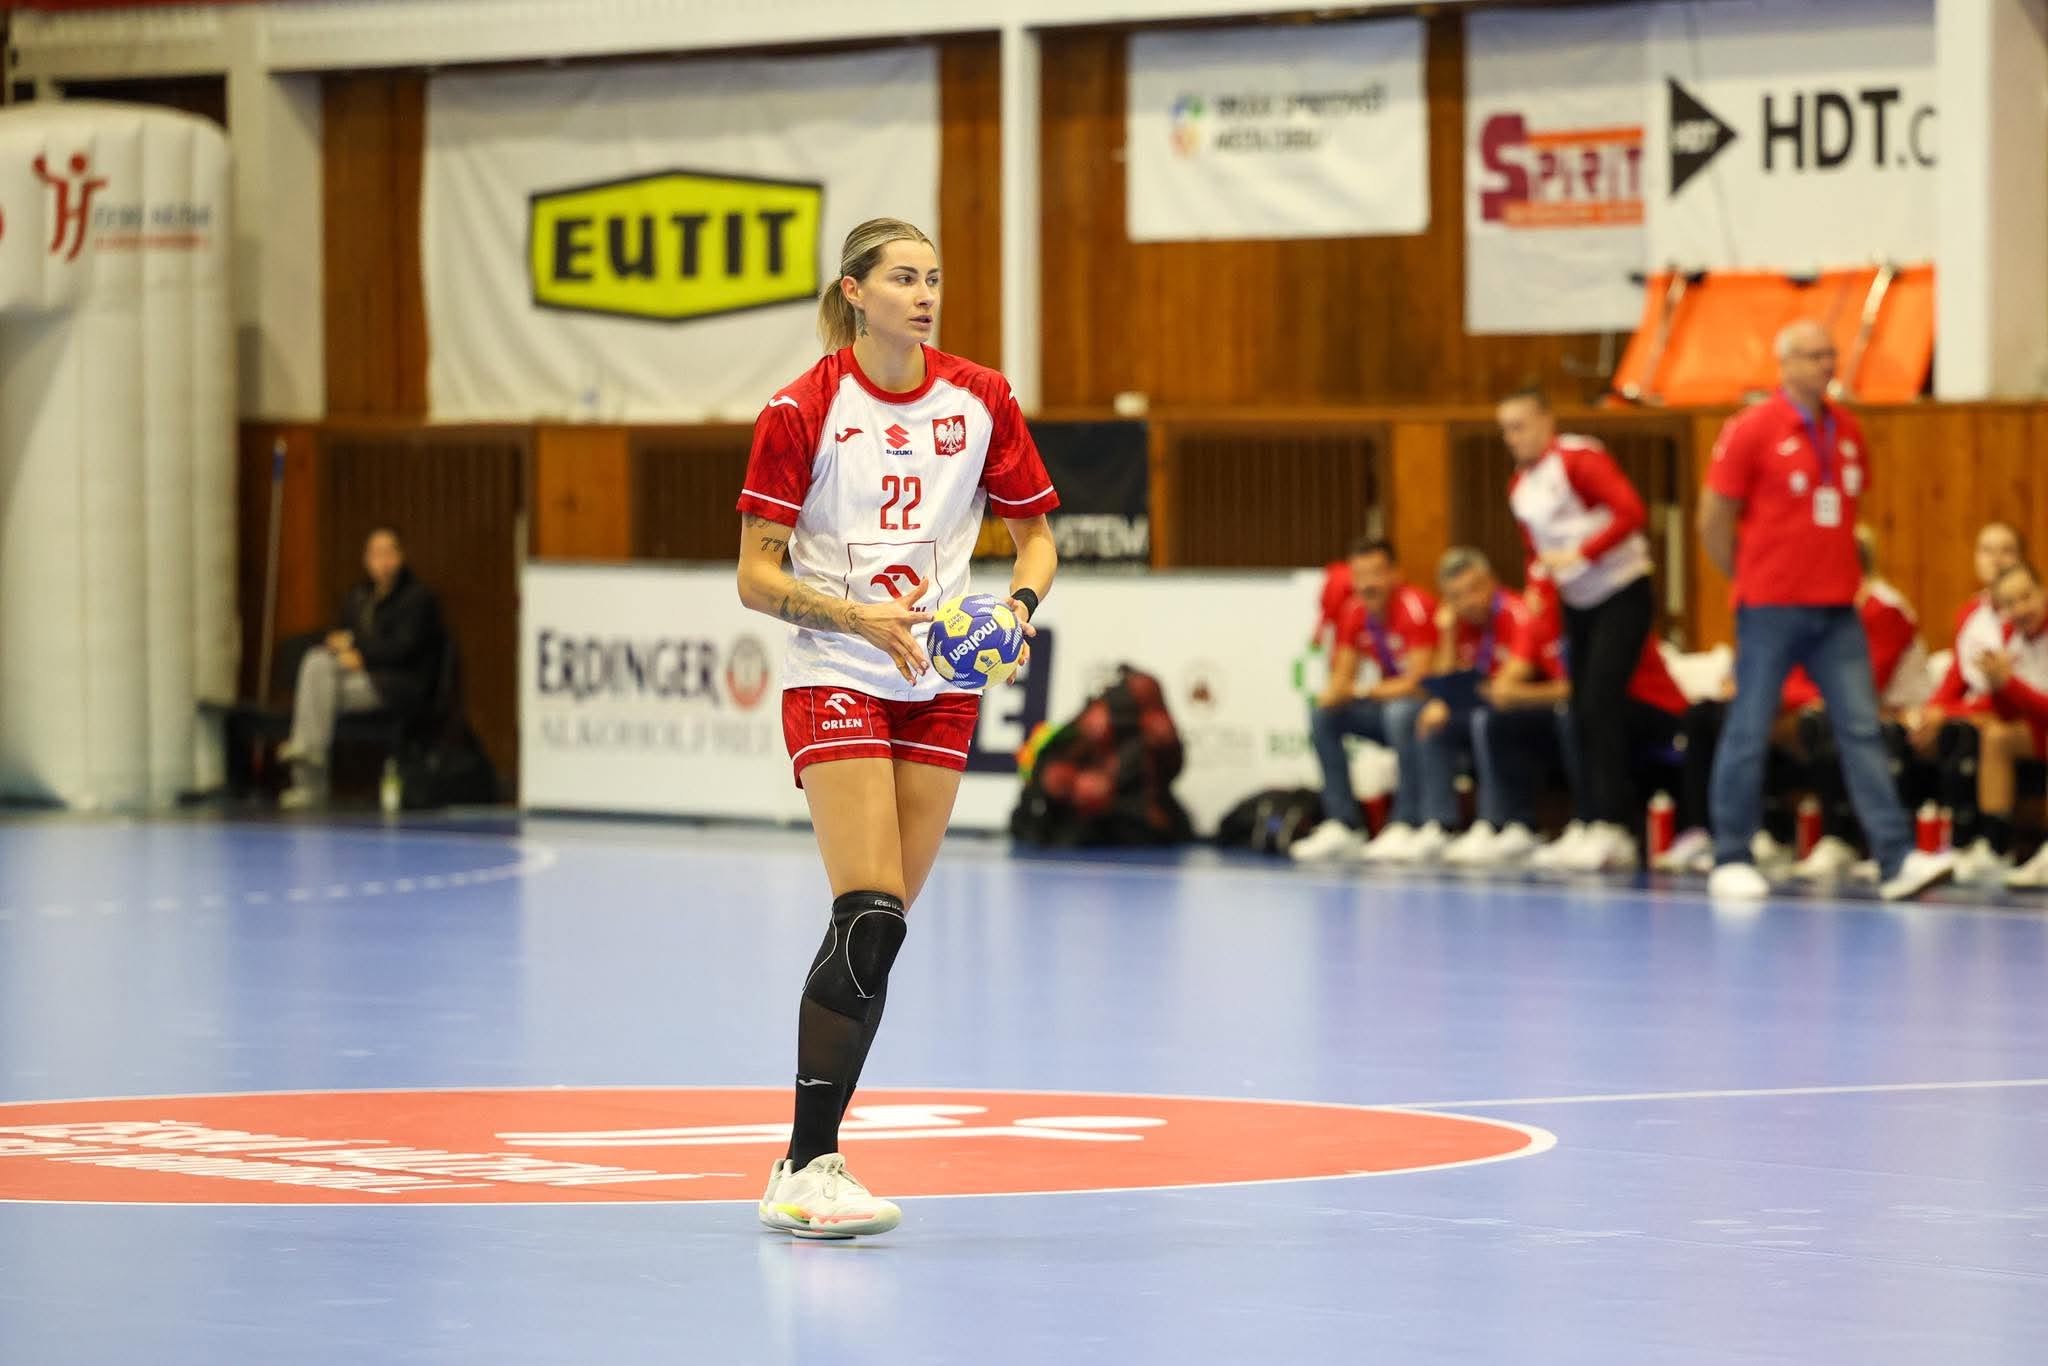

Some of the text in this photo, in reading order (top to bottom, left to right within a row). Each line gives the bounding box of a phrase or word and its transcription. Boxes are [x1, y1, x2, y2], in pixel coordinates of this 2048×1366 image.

[1481, 112, 1642, 221] SPIRIT
[554, 210, 797, 281] EUTIT
[880, 475, 921, 530] 22
[537, 630, 720, 706] ERDINGER
[948, 619, 998, 662] molten
[821, 718, 863, 731] ORLEN
